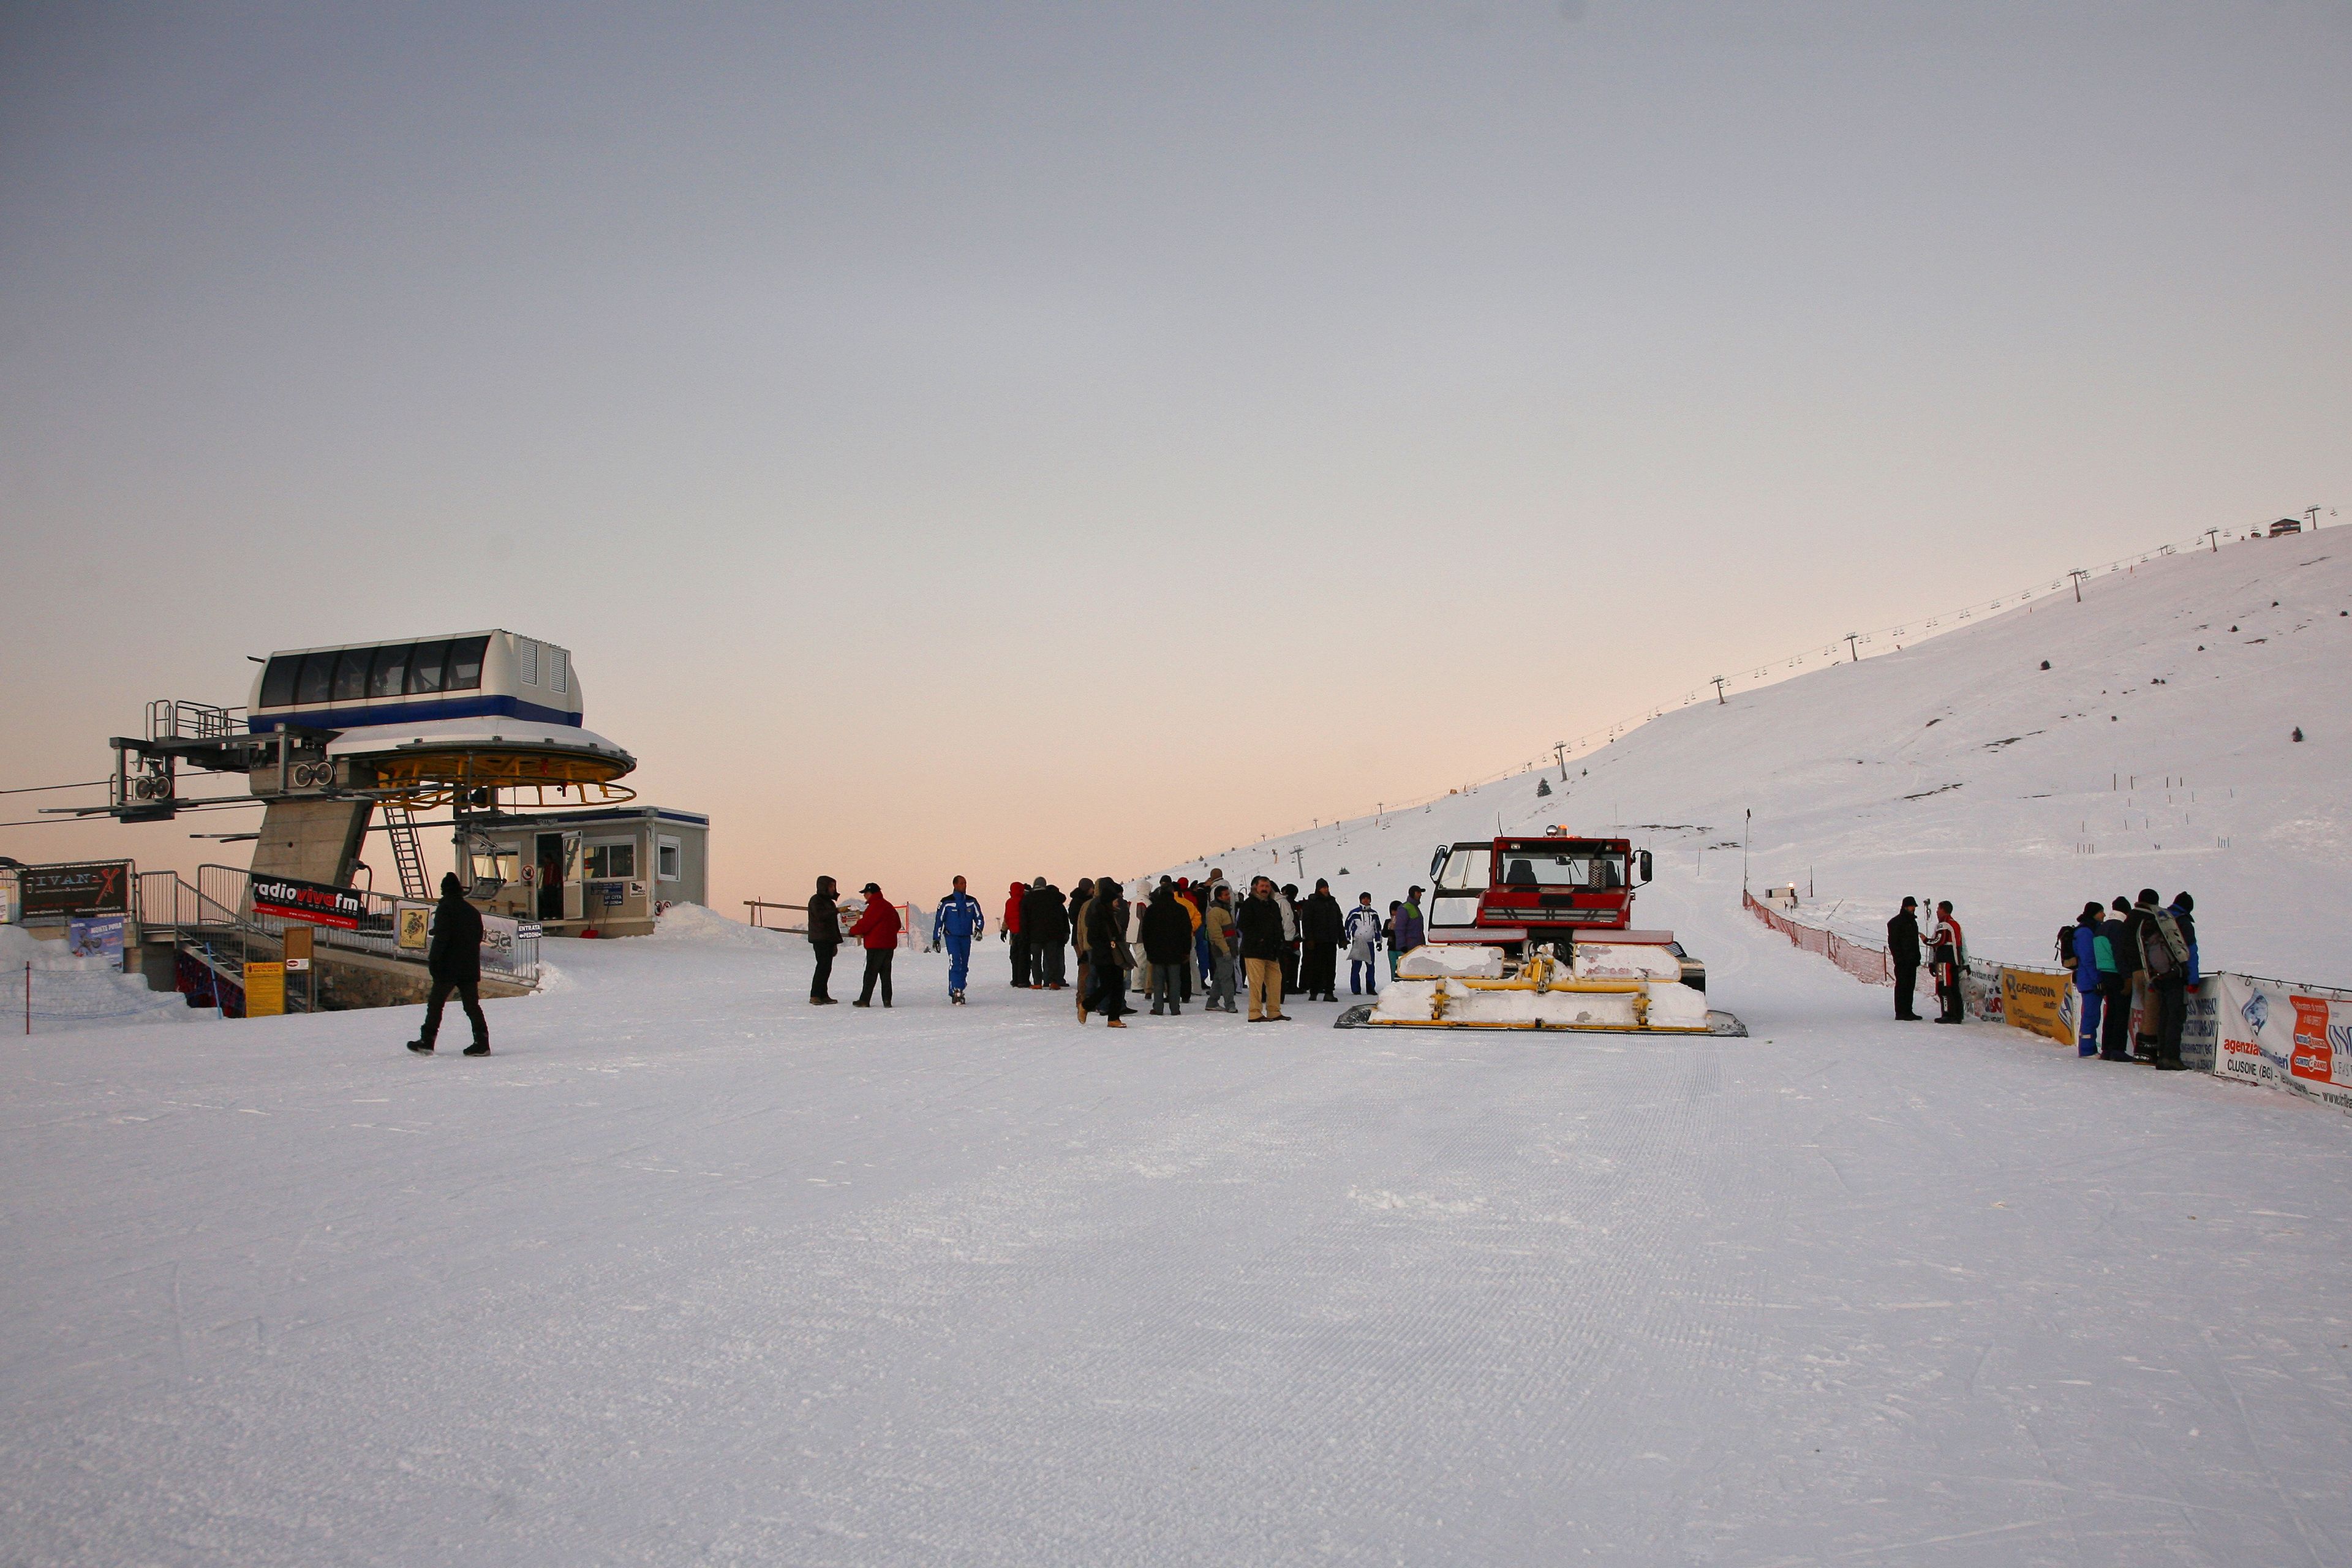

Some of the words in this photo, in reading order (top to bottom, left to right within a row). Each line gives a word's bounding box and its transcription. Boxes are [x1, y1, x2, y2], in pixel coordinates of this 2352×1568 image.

[308, 903, 358, 916] MOVIMENTO
[2227, 1058, 2256, 1076] CLUSONE
[2259, 1064, 2273, 1082] (BG)
